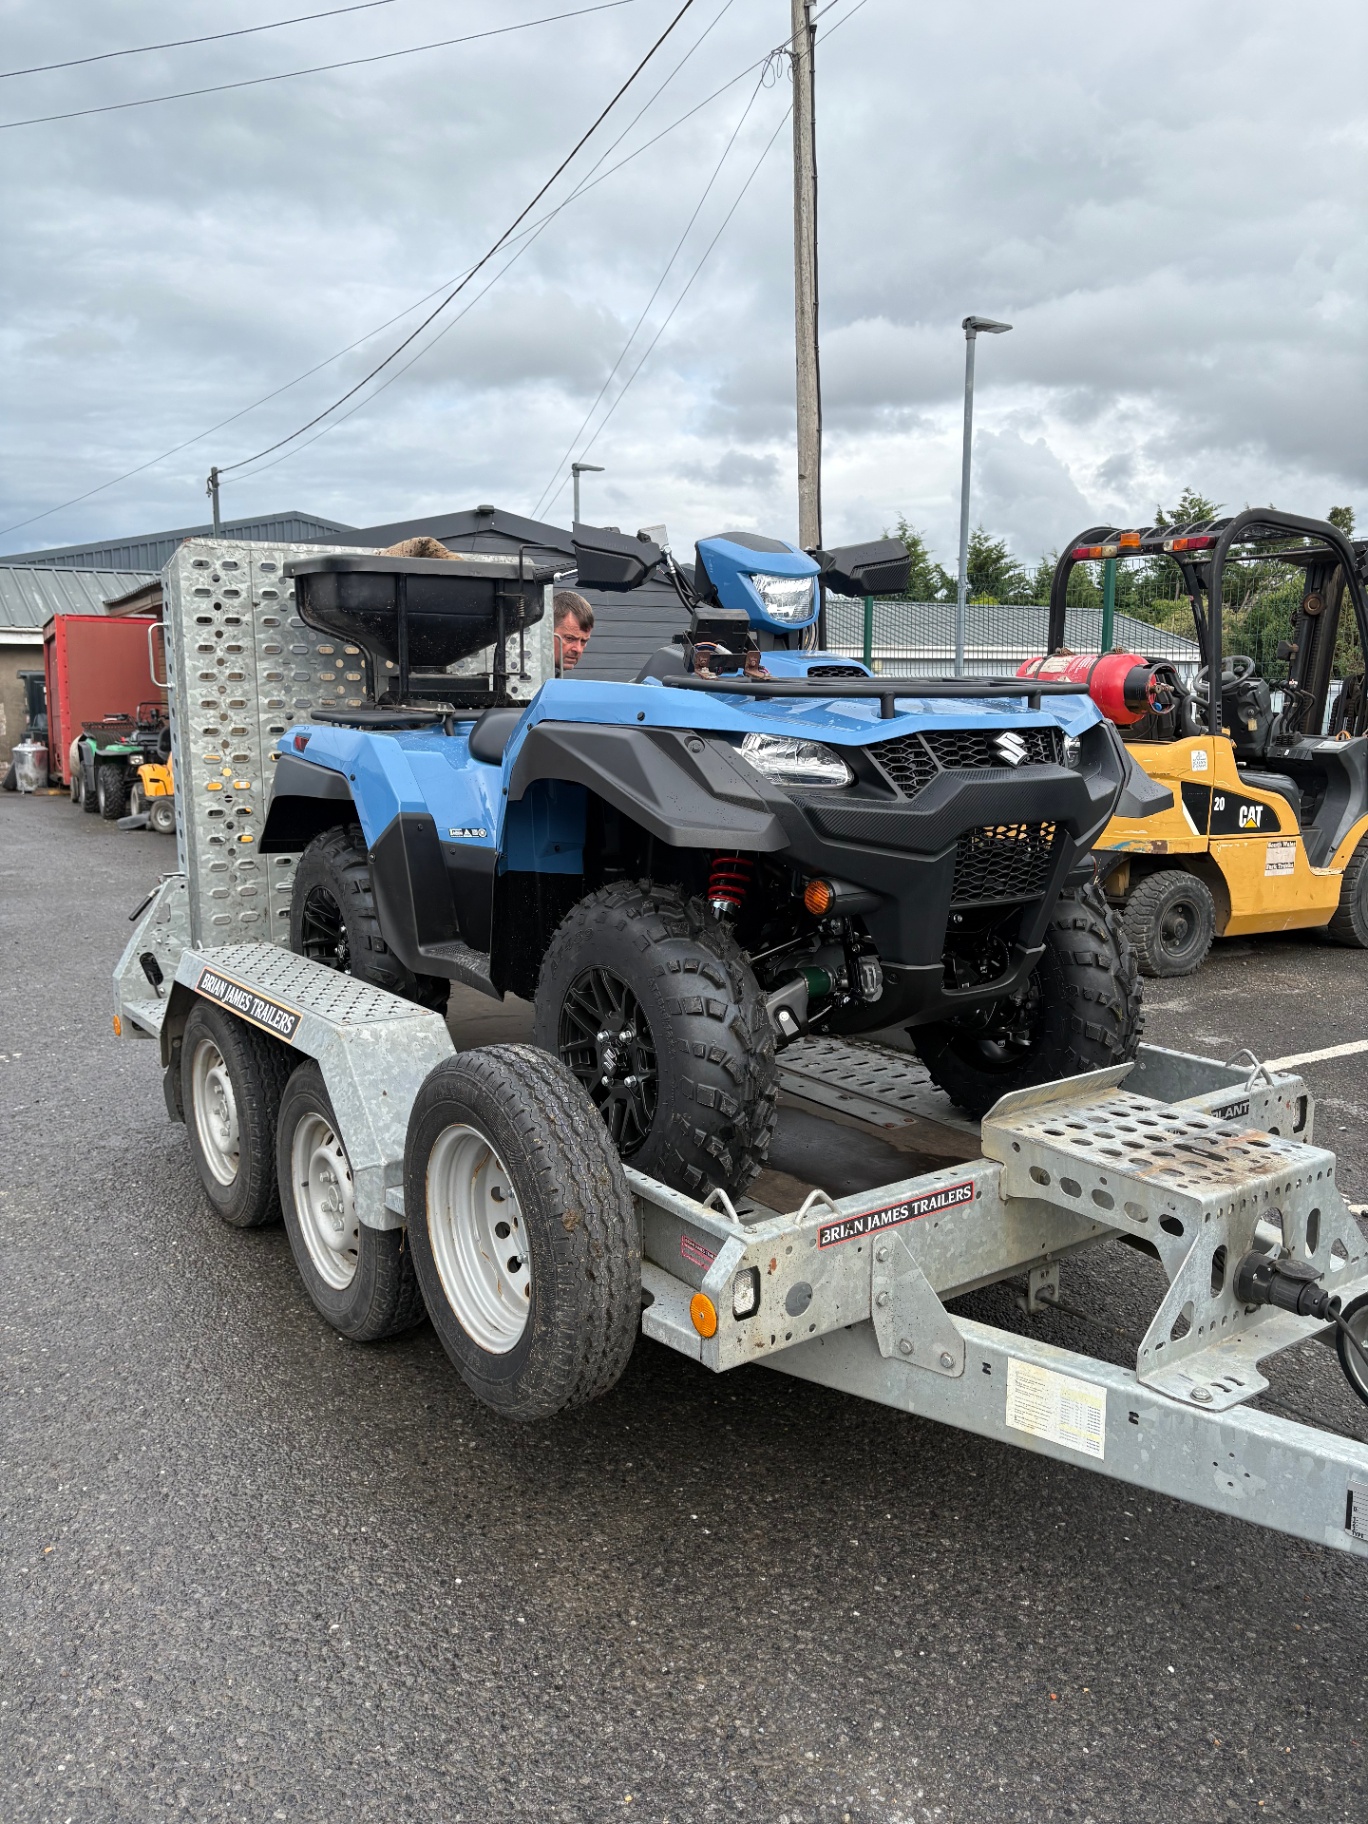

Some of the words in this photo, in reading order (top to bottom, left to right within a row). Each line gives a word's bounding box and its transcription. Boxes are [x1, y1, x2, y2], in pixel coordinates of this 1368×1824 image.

[1214, 797, 1225, 811] 20
[1239, 805, 1263, 828] CAT
[201, 973, 227, 998] BRIAN
[221, 985, 253, 1011] JAMES
[249, 998, 295, 1034] TRAILERS
[821, 1219, 864, 1244] BRIAN
[865, 1205, 909, 1232] JAMES
[912, 1185, 972, 1215] TRAILERS
